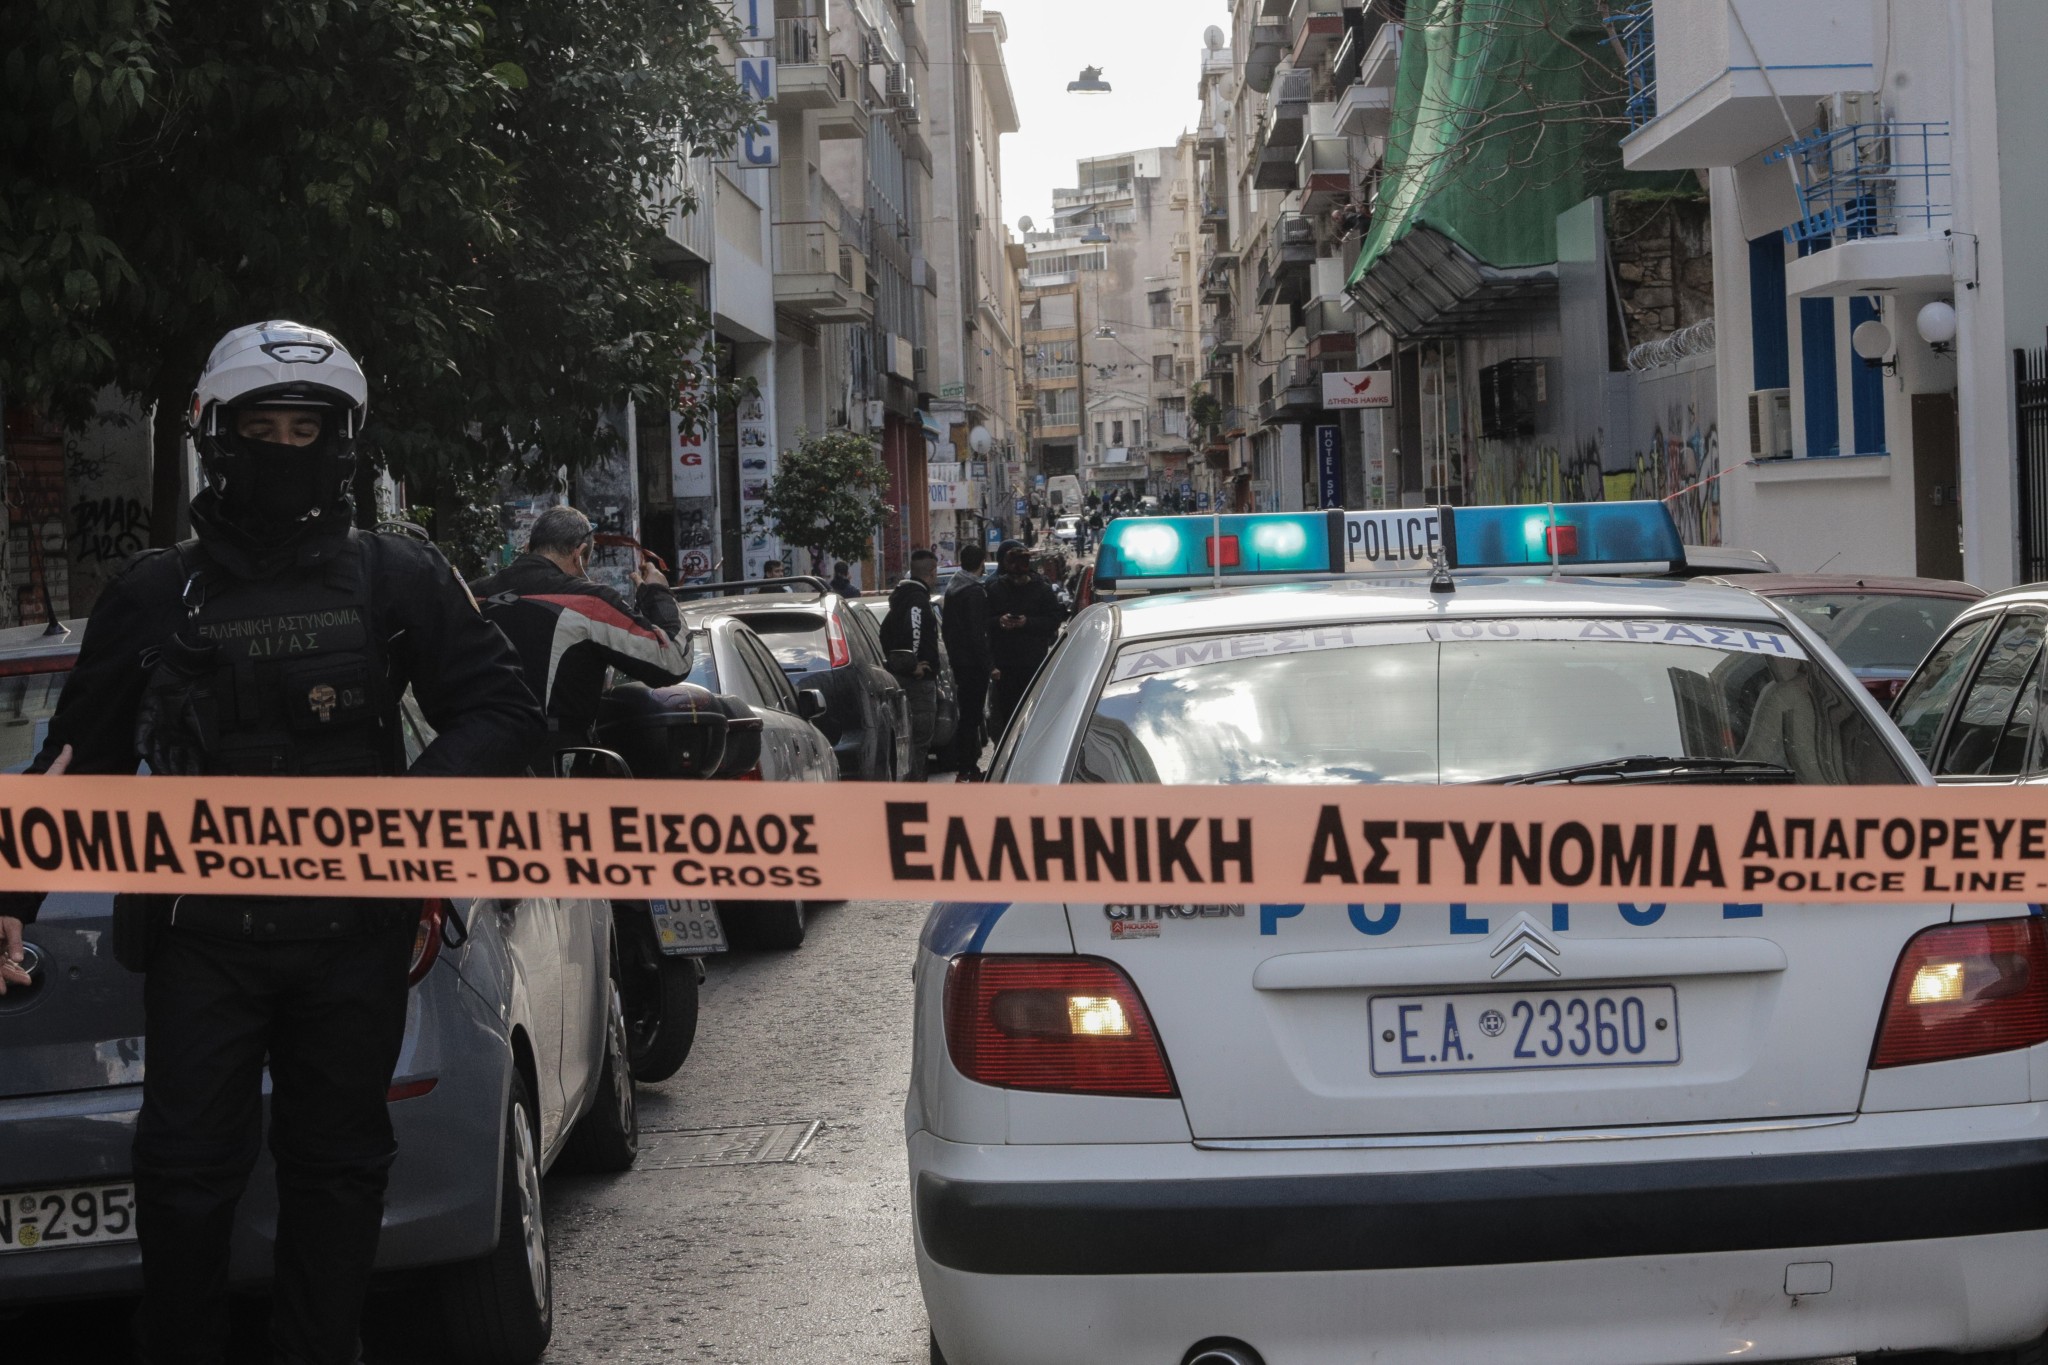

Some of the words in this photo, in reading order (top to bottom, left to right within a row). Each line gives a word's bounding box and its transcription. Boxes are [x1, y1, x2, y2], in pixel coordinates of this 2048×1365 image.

[1360, 396, 1389, 404] HAWKS
[1324, 430, 1333, 475] HOTEL
[1327, 480, 1335, 507] SPA
[989, 530, 997, 539] P
[1347, 517, 1440, 563] POLICE
[199, 618, 272, 640] ΕΛΛΗΝΙΚΗ
[277, 608, 361, 633] ΑΣΤΥΝΟΜΙΑ
[1126, 629, 1355, 677] ΑΜΕΣΗ
[1578, 623, 1787, 653] ΔΡΑΣΗ
[188, 798, 543, 852] ΑΠΑΓΟΡΕΥΕΤΑΙ
[608, 804, 822, 855] ΕΙΣΟΔΟΣ
[886, 802, 1253, 883] ΕΛΛΗΝΙΚΗ
[1304, 805, 1726, 887] ΑΣΤΥΝΟΜΙΑ
[194, 849, 348, 881] POLICE
[356, 852, 459, 883] LINE
[486, 855, 553, 886] DO
[565, 857, 657, 888] NOT
[672, 859, 824, 888] CROSS
[1743, 865, 1905, 892] POLICE
[1923, 866, 2026, 893] LINE
[674, 919, 719, 940] 998
[1260, 903, 1763, 936] POLI
[1511, 996, 1647, 1059] 23360
